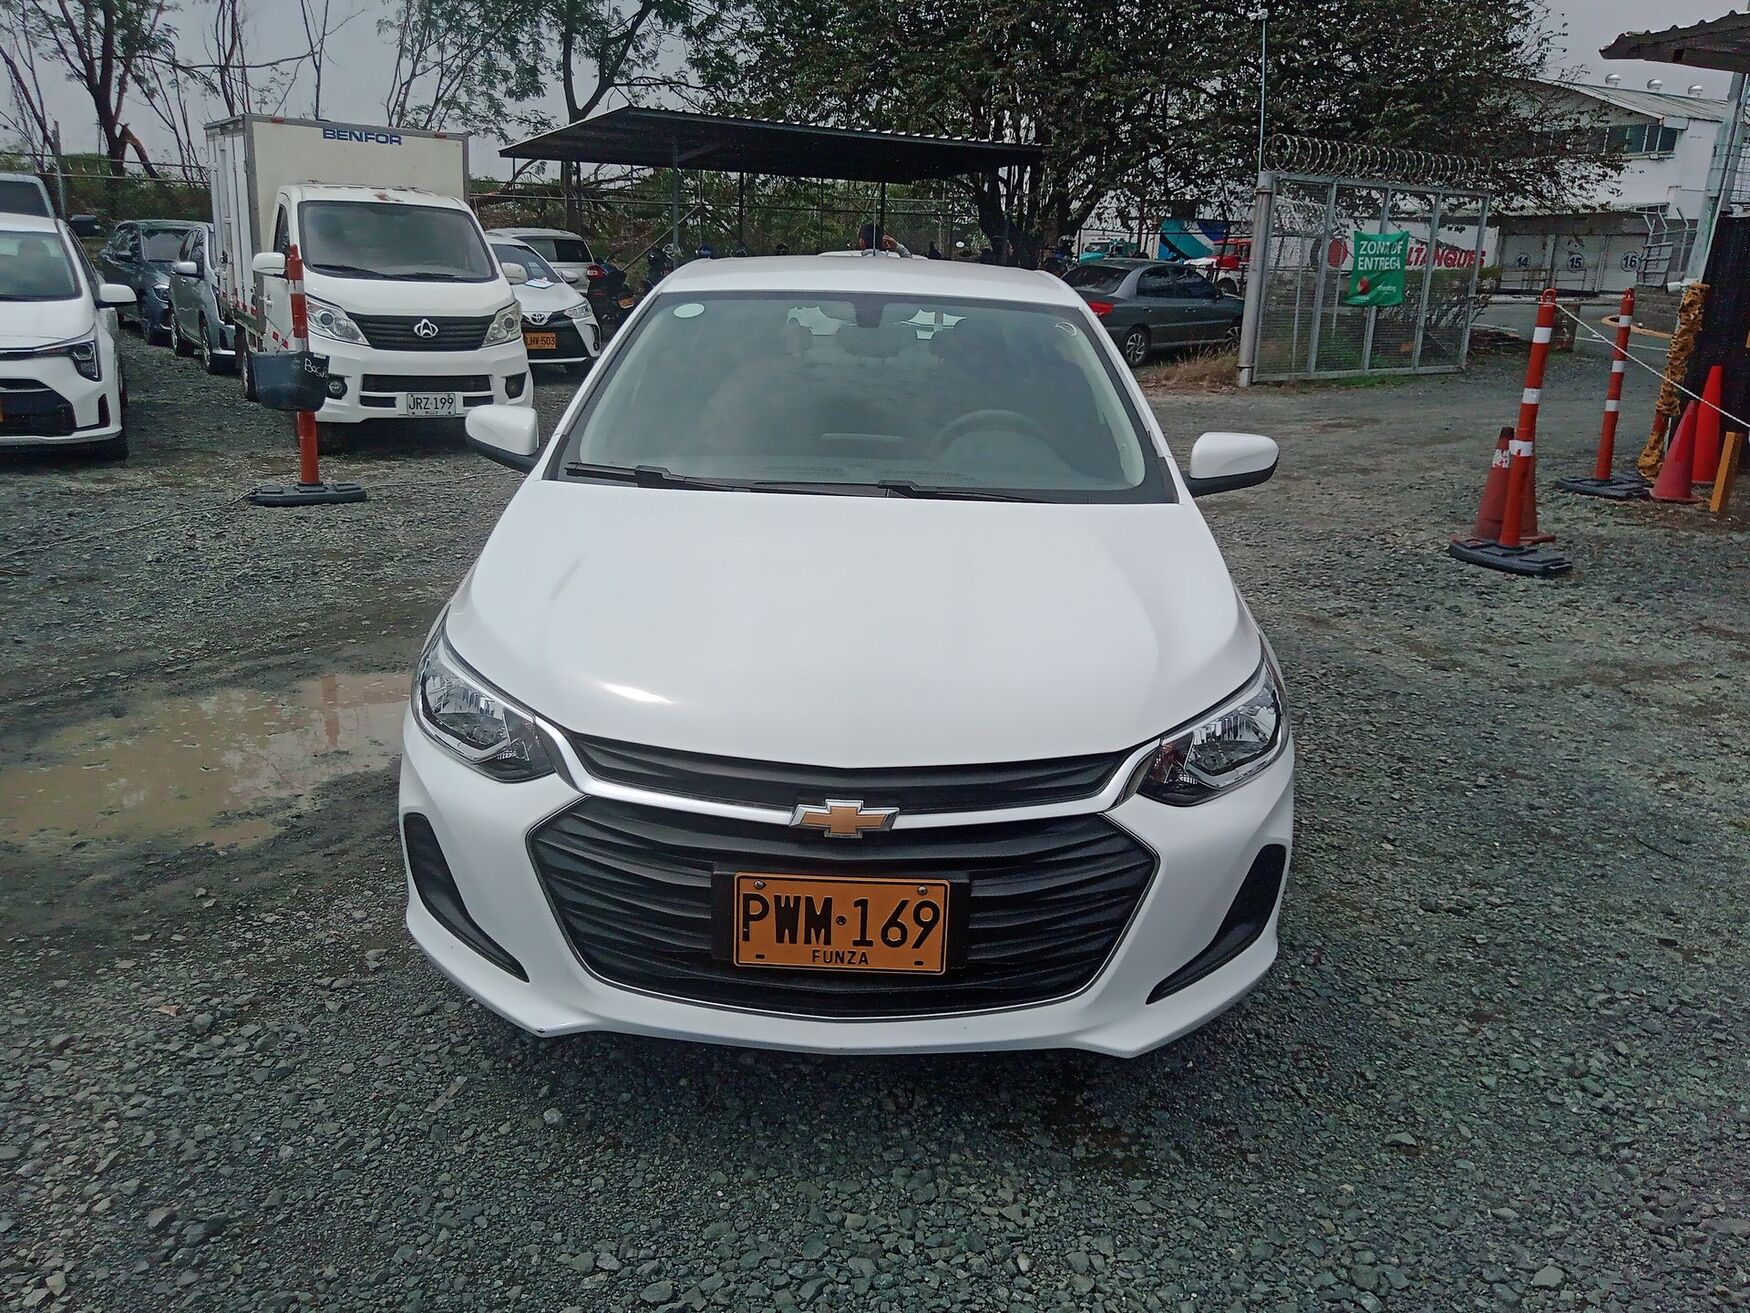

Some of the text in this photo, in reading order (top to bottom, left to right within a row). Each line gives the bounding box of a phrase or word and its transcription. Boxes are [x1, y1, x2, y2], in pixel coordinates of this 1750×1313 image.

[322, 128, 402, 146] BENFOR
[1359, 240, 1390, 255] ZONA
[1357, 256, 1401, 271] ENTREGA
[1516, 256, 1528, 268] 14
[1569, 256, 1582, 269] 15
[1622, 255, 1637, 268] 16
[811, 949, 869, 966] FUNZA
